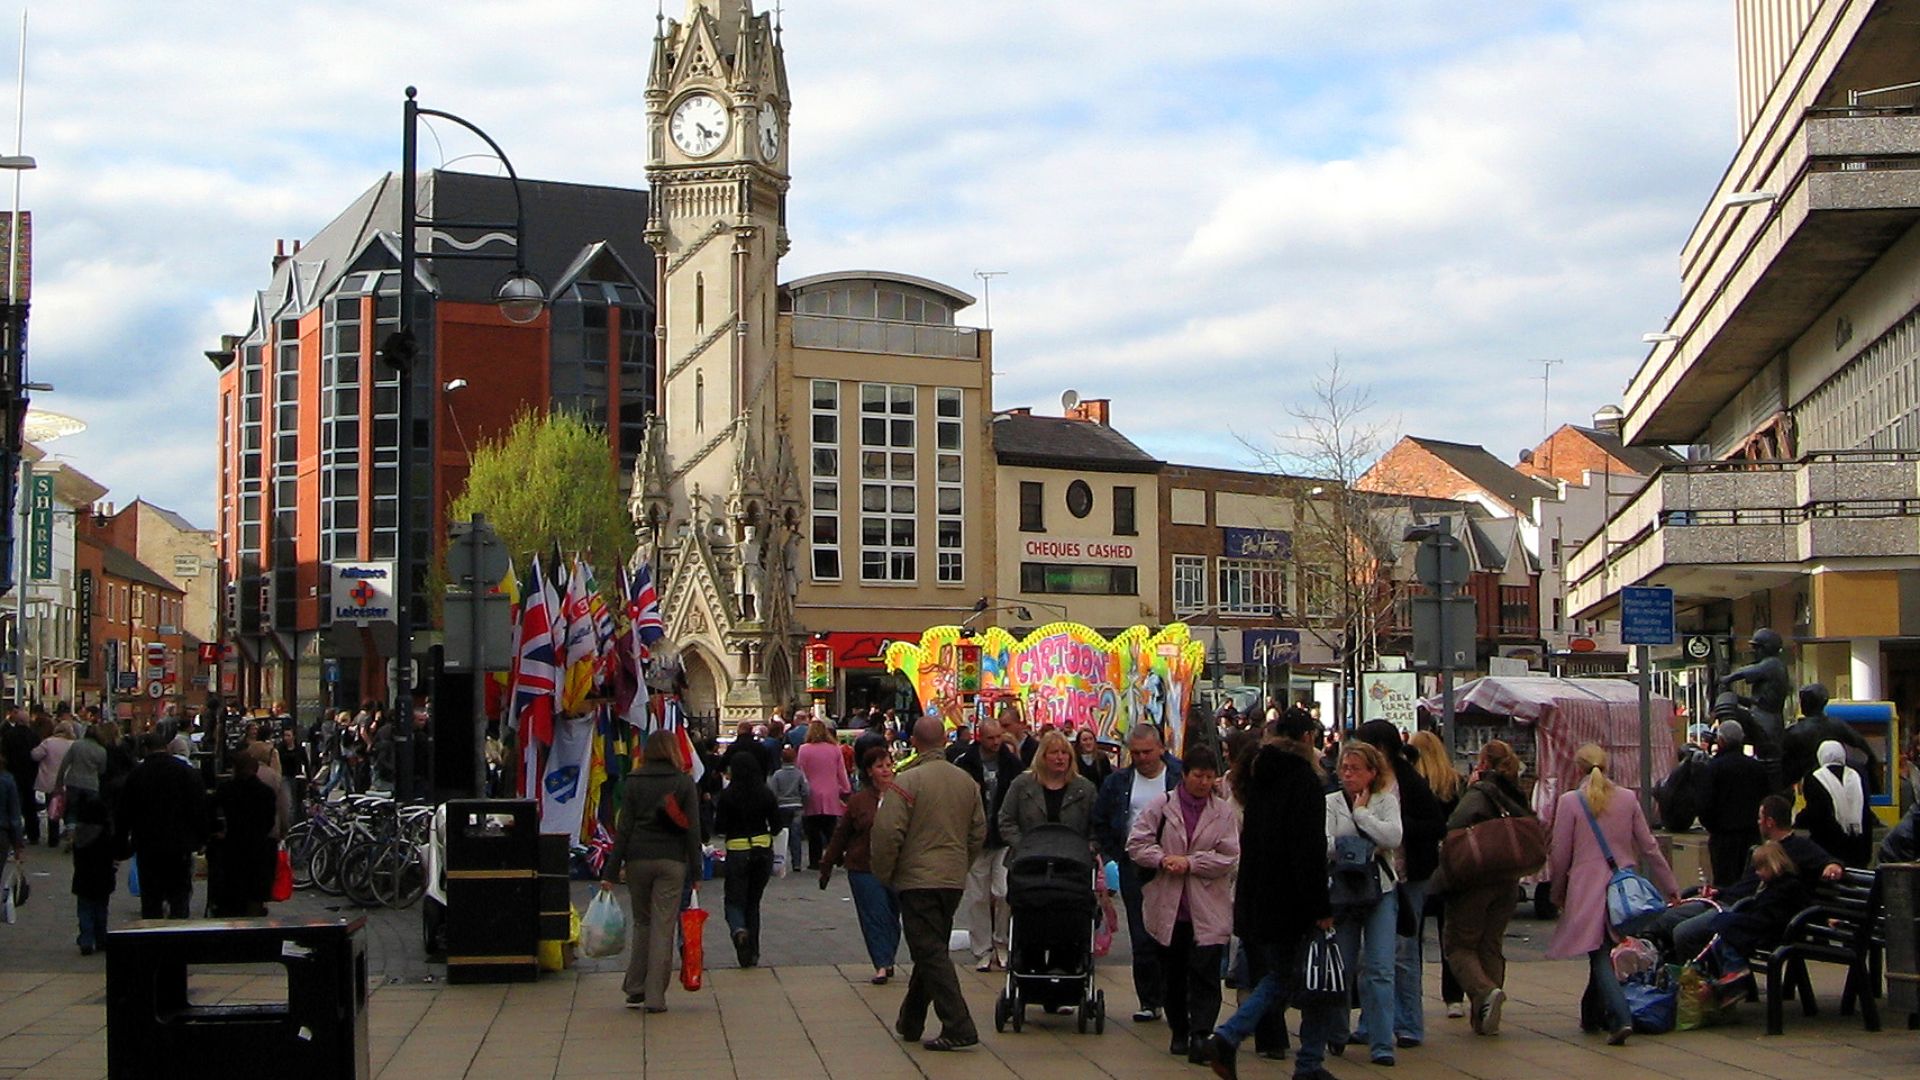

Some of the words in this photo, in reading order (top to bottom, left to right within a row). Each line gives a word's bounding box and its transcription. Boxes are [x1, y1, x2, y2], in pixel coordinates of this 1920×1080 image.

[36, 479, 50, 574] SHIRES
[1026, 541, 1080, 558] CHEQUES
[1087, 544, 1133, 559] CASHED
[340, 566, 388, 579] Alliance
[336, 605, 389, 617] Leicester
[1016, 633, 1110, 684] CARTOON
[1389, 693, 1411, 701] NEW
[1381, 701, 1411, 711] NAME
[1385, 711, 1413, 720] SAME
[1306, 940, 1345, 992] GAP
